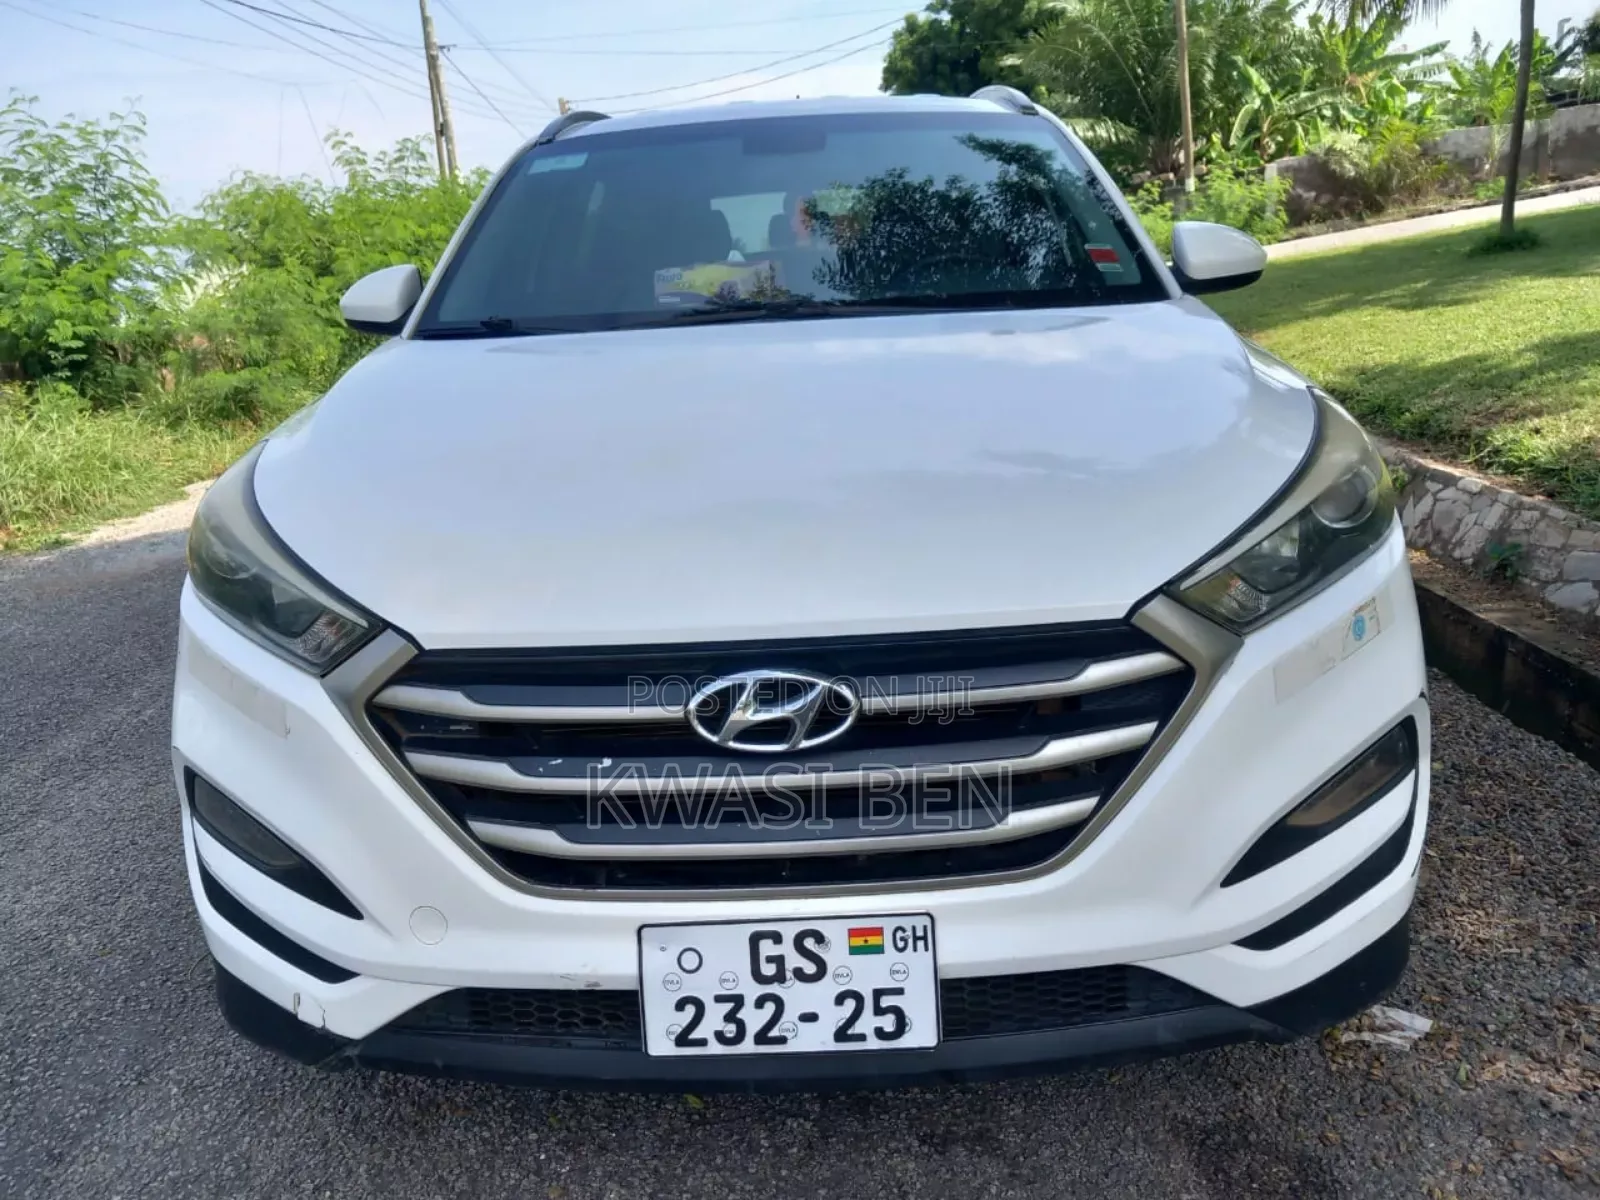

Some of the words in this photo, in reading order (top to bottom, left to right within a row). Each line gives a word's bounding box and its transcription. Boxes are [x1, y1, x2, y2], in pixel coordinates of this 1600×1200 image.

[748, 928, 828, 985] GS
[891, 924, 930, 953] GH
[674, 986, 907, 1048] 232-25
